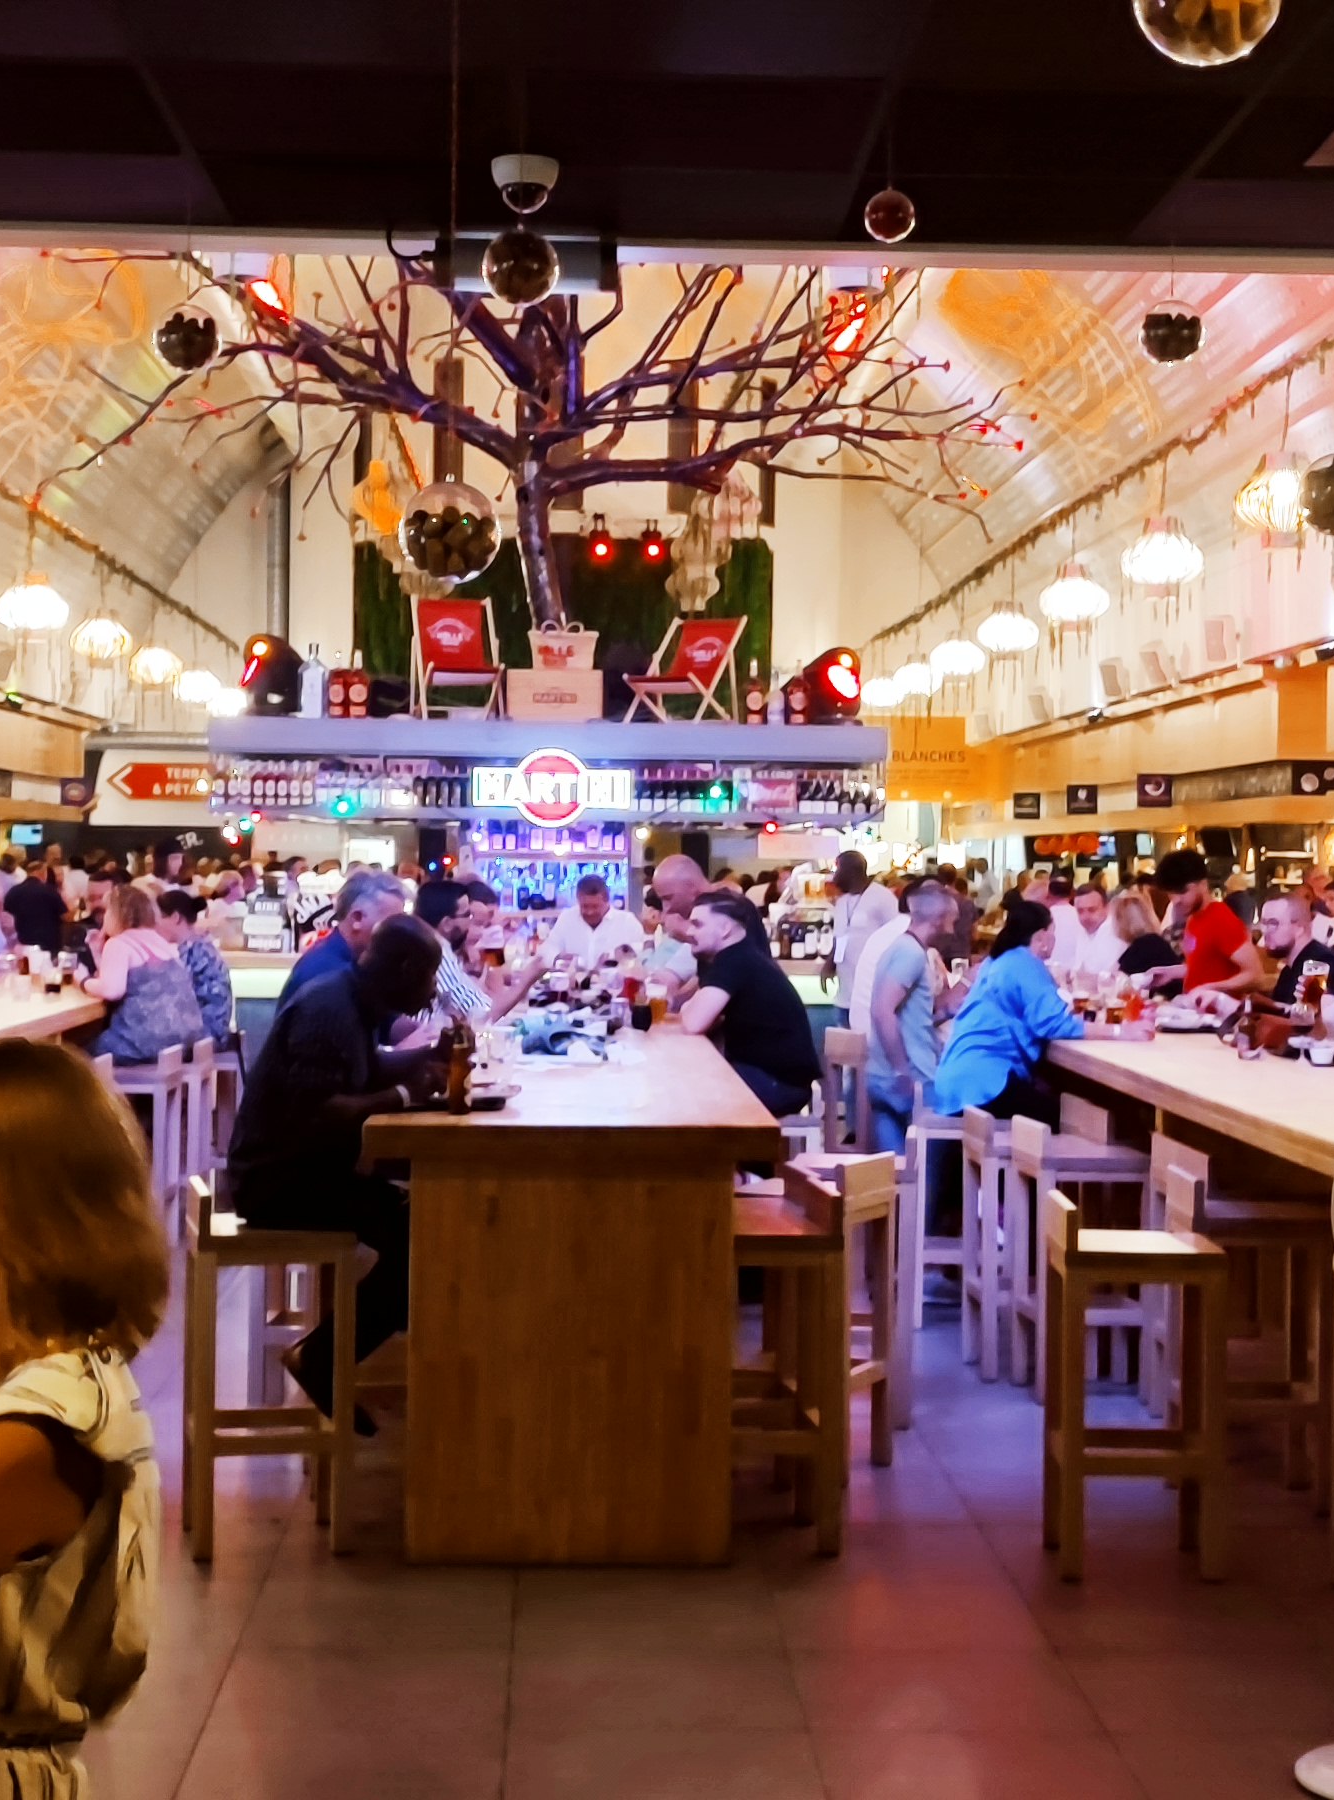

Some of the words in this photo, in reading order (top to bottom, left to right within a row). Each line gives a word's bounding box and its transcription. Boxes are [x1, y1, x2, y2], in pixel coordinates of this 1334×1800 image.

[892, 750, 966, 763] BLANCHES
[166, 768, 210, 780] TERRA
[165, 783, 199, 796] PETA
[476, 770, 627, 805] MARTINI
